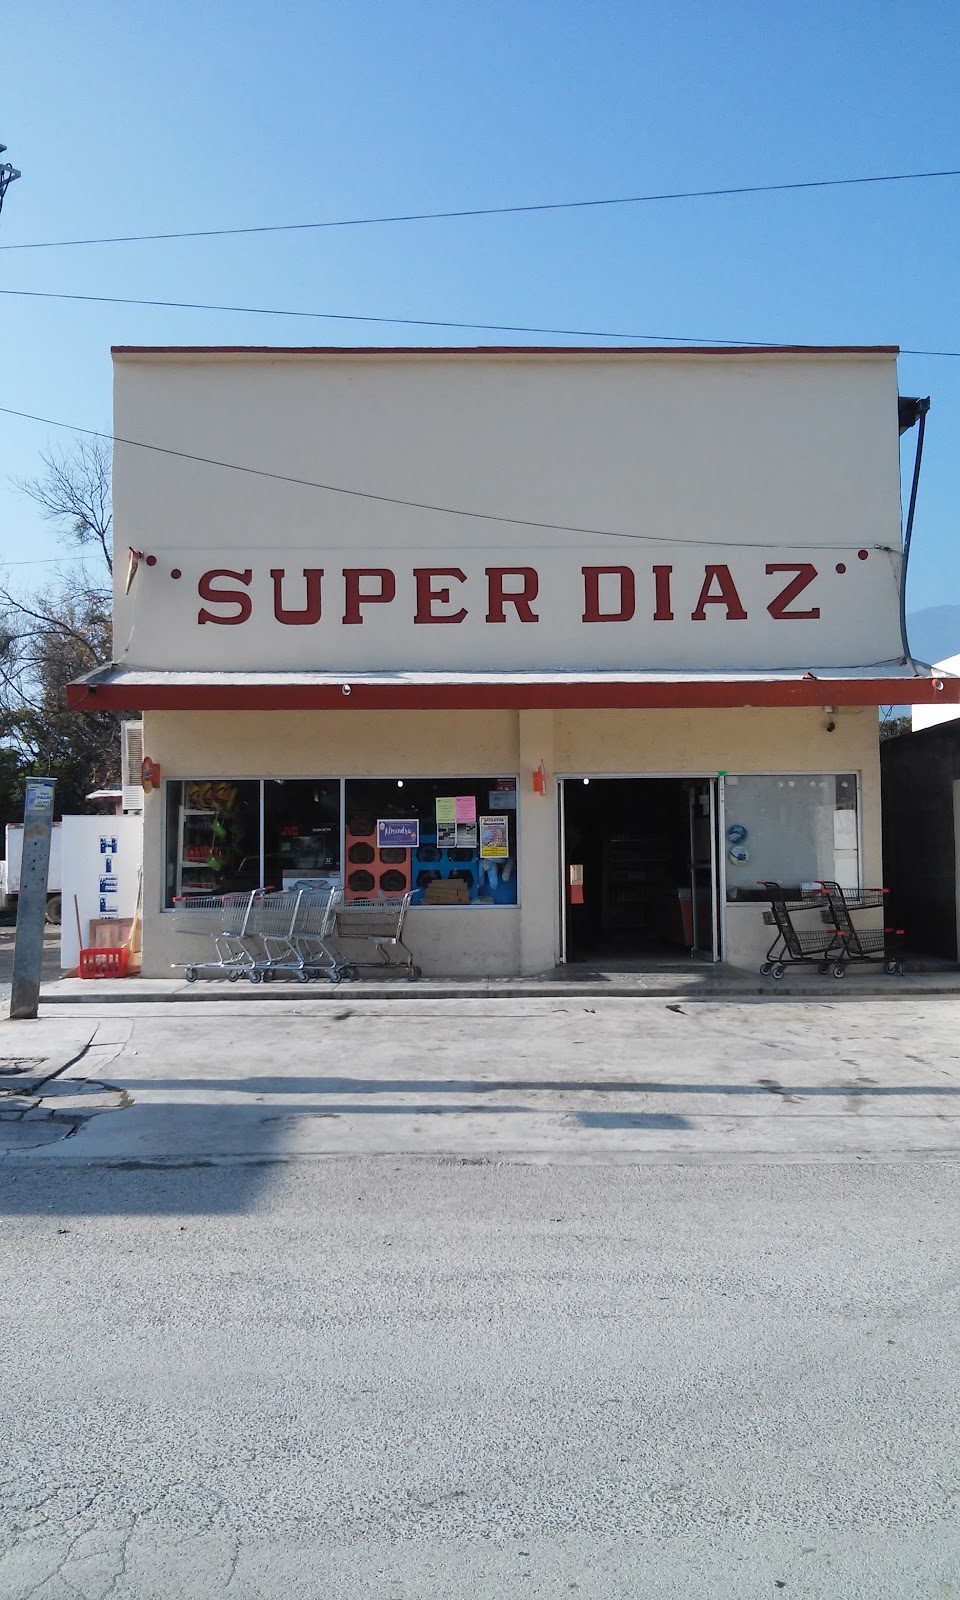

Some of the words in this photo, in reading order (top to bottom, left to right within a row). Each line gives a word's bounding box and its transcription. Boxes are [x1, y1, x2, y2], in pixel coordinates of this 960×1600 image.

[199, 568, 538, 624] SUPER
[583, 564, 818, 622] DIAZ
[281, 826, 298, 836] JVC
[99, 836, 118, 920] HIEL
